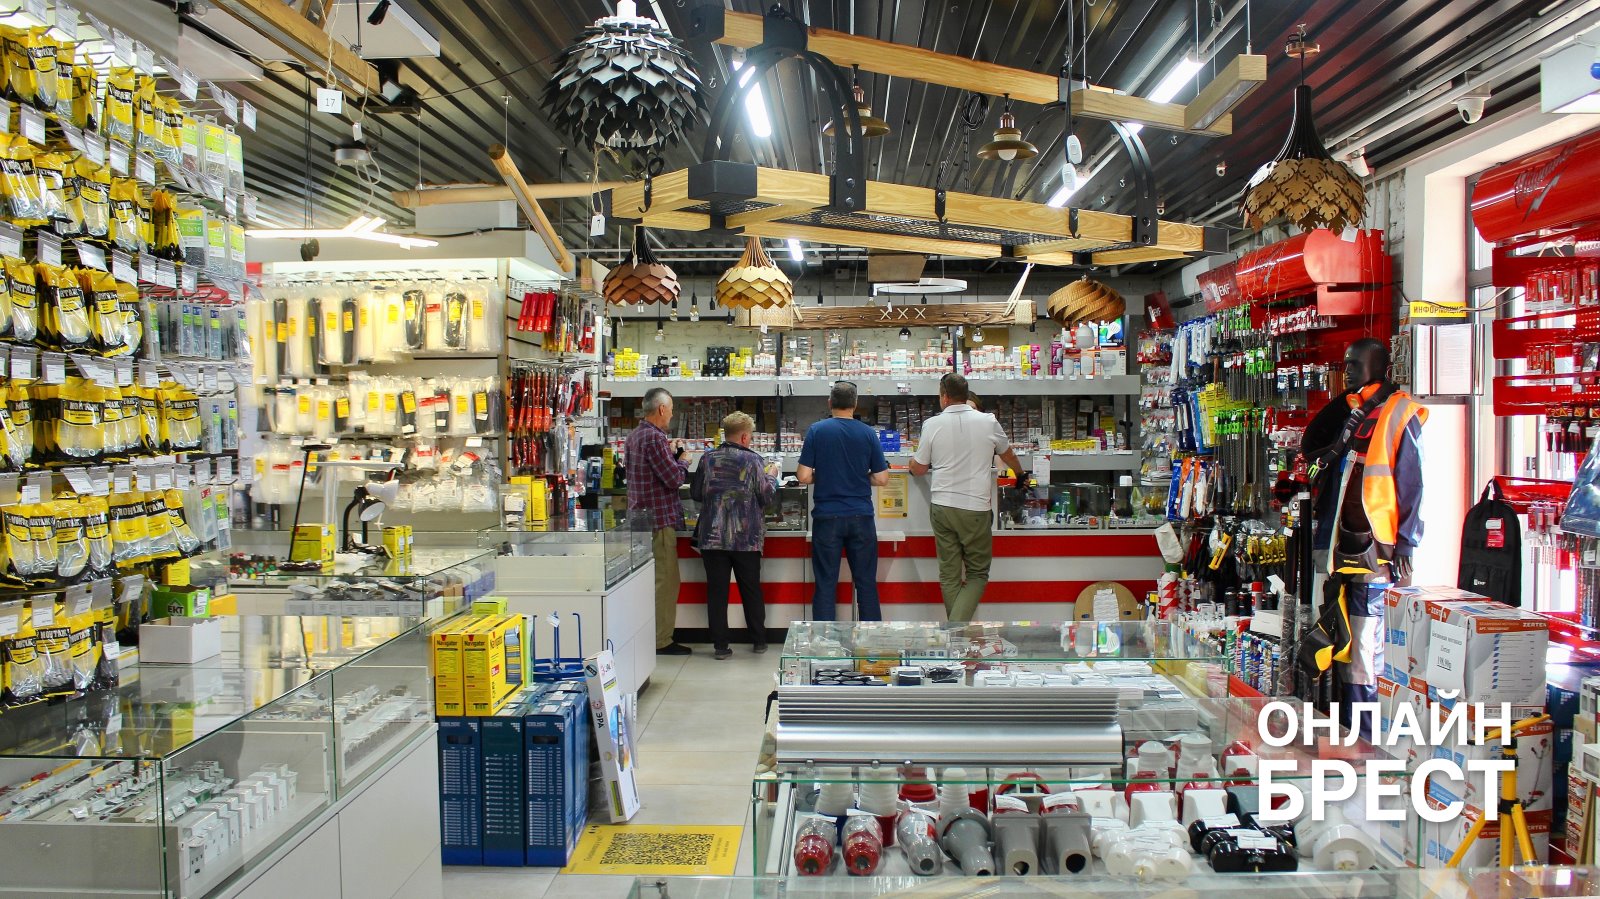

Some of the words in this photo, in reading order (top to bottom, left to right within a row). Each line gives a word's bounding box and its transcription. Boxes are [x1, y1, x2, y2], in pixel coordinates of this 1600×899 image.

[325, 97, 336, 107] 17
[1218, 283, 1231, 297] EKF
[168, 605, 184, 614] EKT
[595, 712, 604, 728] ЭРА
